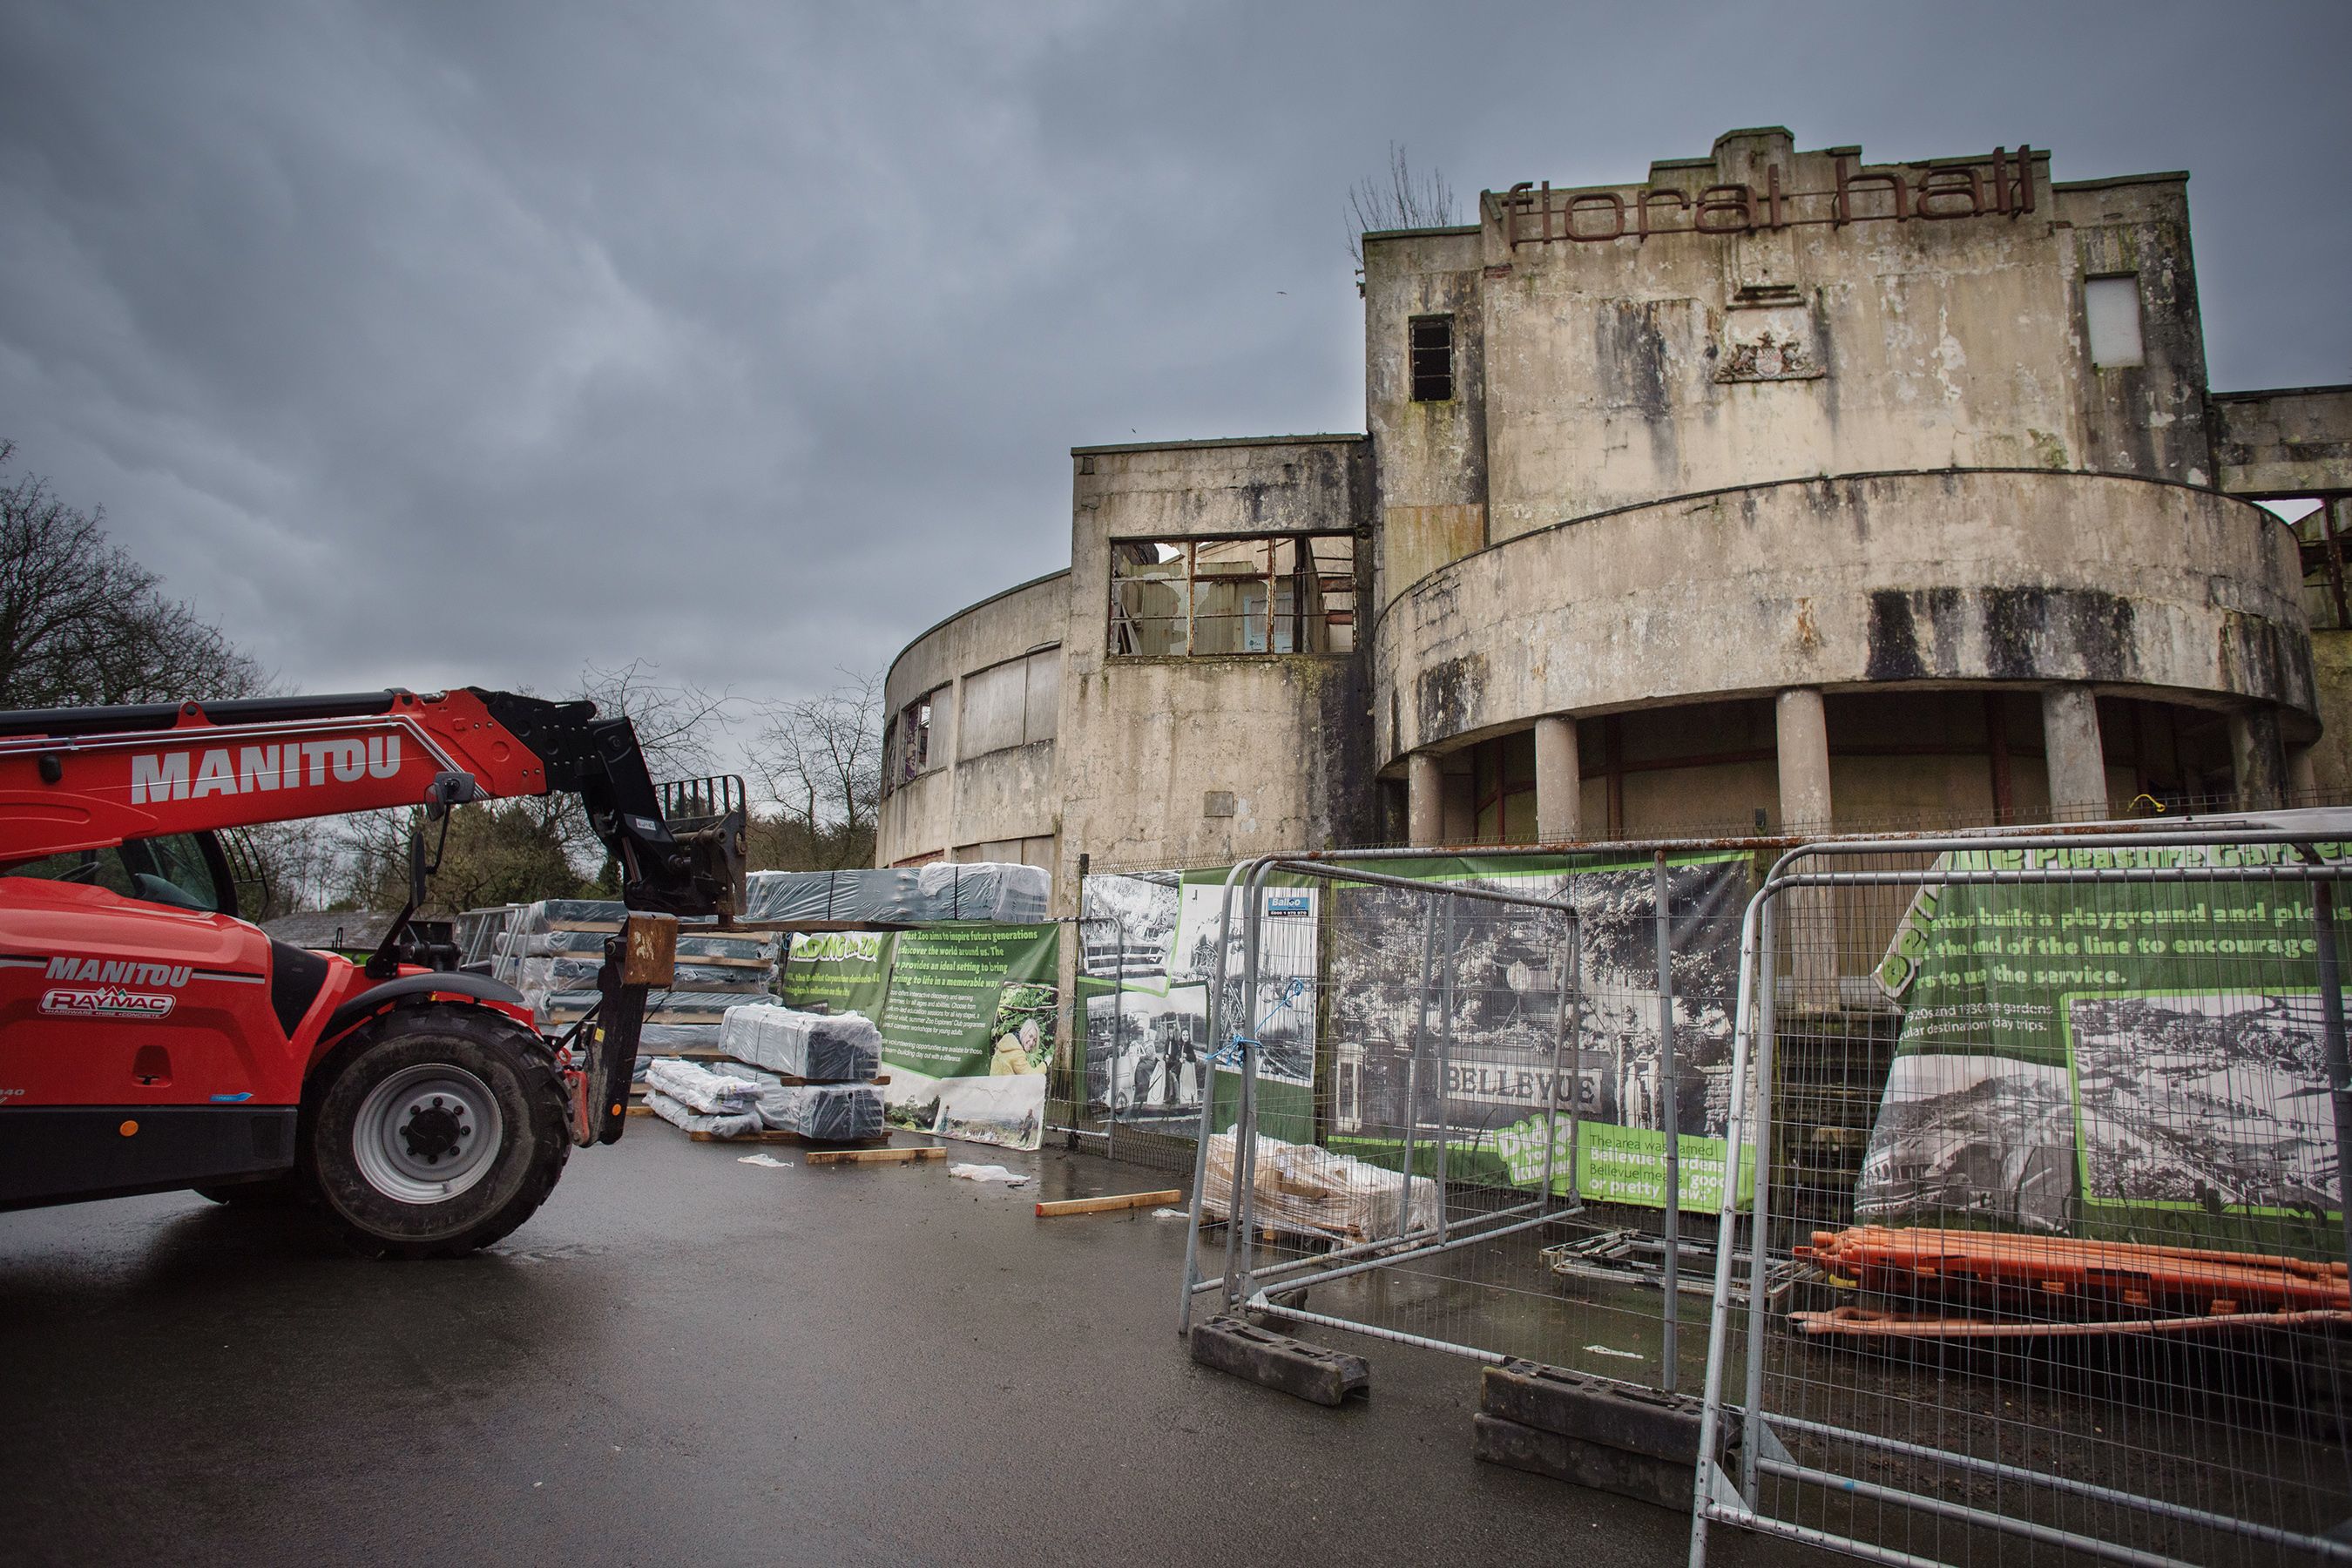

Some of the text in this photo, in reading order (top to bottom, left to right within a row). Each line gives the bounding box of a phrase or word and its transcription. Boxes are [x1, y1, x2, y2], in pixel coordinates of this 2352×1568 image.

[1502, 145, 2035, 248] floral hall
[132, 735, 400, 805] MANITOU
[1979, 907, 2033, 927] built
[2039, 914, 2053, 927] a
[2061, 903, 2206, 931] playground
[2213, 902, 2266, 923] and
[918, 932, 929, 941] Zoo
[929, 931, 942, 941] aims
[943, 932, 949, 941] to
[950, 931, 970, 943] inspire
[970, 930, 991, 941] future
[992, 929, 1037, 943] generations
[928, 946, 938, 956] the
[939, 945, 957, 956] world
[959, 946, 979, 956] around
[990, 946, 1004, 956] The
[1935, 938, 1967, 958] the
[2006, 936, 2034, 955] of
[2038, 936, 2078, 955] the
[2085, 936, 2132, 955] line
[2137, 936, 2166, 955] to
[2173, 937, 2317, 958] encourage
[45, 956, 192, 987] MANITOU
[901, 960, 929, 970] provides
[940, 961, 956, 970] ideal
[956, 962, 980, 974] setting
[990, 962, 1008, 975] bring
[1939, 970, 1961, 985] to
[1994, 963, 2027, 983] the
[2034, 965, 2127, 983] service.
[914, 976, 921, 984] to
[923, 975, 933, 984] life
[935, 976, 942, 985] in
[947, 977, 984, 987] memorable
[986, 980, 1000, 990] way.
[51, 992, 166, 1010] RAYMAC
[2004, 1003, 2053, 1015] gardens
[1992, 1017, 2013, 1031] day
[2017, 1019, 2047, 1033] trips.
[1448, 1064, 1595, 1104] BELLEVUE
[1590, 1134, 1713, 1157] The area was amed
[1591, 1147, 1655, 1166] Bellevue
[1590, 1163, 1639, 1179] Bellevue
[1590, 1178, 1606, 1190] or
[1610, 1181, 1659, 1200] pretty
